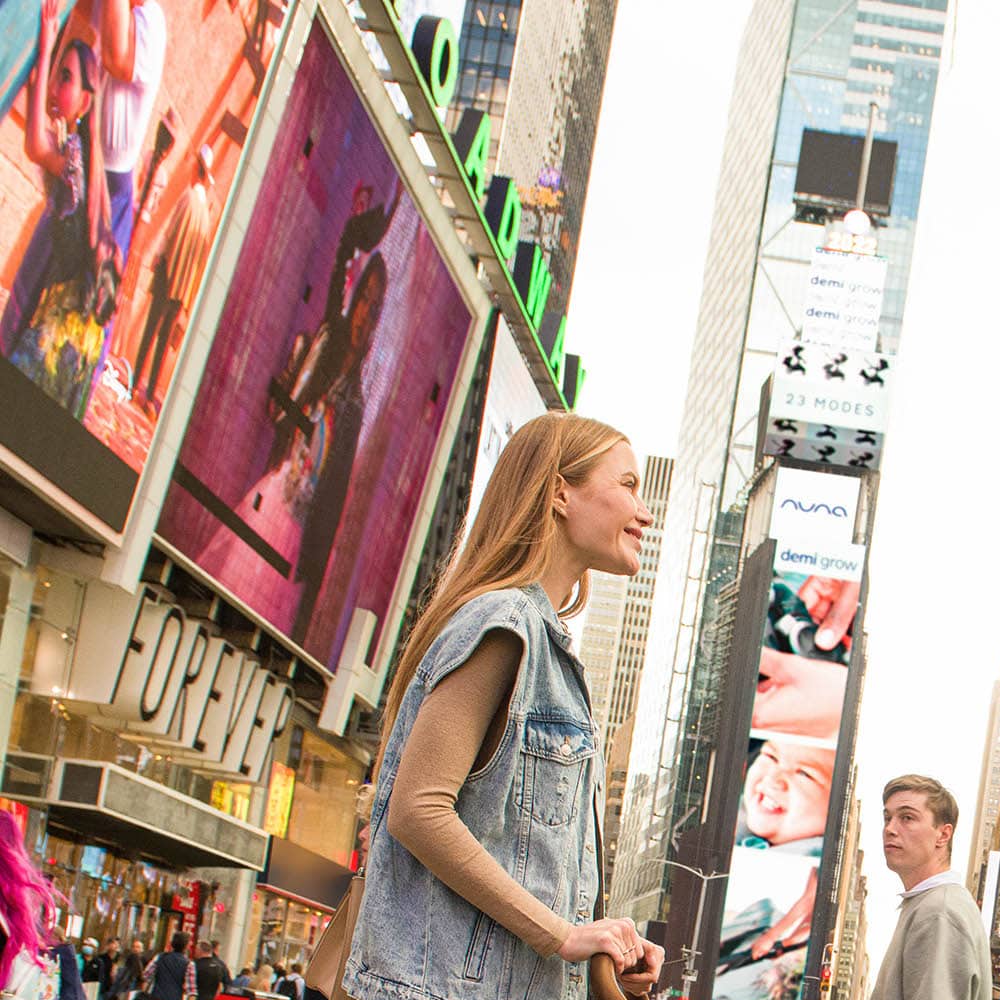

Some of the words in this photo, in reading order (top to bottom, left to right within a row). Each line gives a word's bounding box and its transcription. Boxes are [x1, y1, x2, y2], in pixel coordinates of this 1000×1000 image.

[388, 0, 588, 414] OADWAY
[810, 275, 845, 289] demi
[806, 307, 840, 321] demi
[786, 393, 807, 407] 23
[814, 398, 876, 417] MODES
[780, 498, 849, 518] nuna
[780, 549, 818, 566] demi
[820, 556, 859, 571] grow
[108, 586, 297, 783] FOREVER
